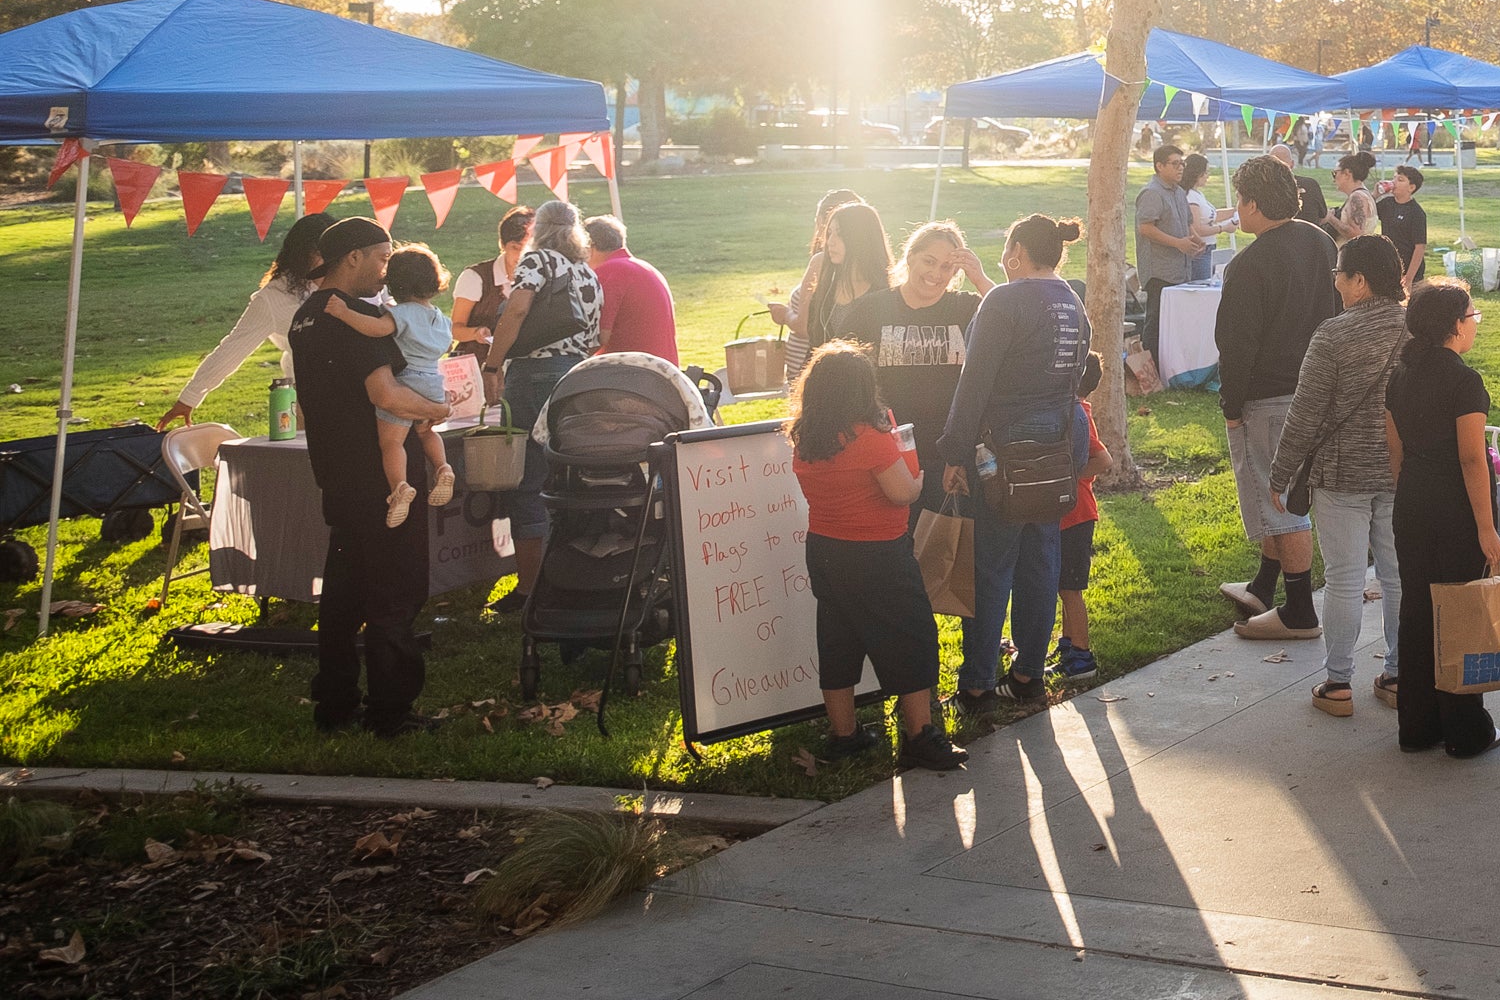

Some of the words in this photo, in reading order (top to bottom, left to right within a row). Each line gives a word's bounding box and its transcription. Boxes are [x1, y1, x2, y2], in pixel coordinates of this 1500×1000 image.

[878, 324, 967, 367] MAMA
[686, 454, 750, 491] Visit
[762, 461, 789, 477] our
[697, 501, 757, 533] booths
[767, 494, 798, 514] with
[701, 541, 748, 574] flags
[764, 531, 781, 551] to
[715, 575, 770, 623] FREE
[756, 615, 784, 641] or
